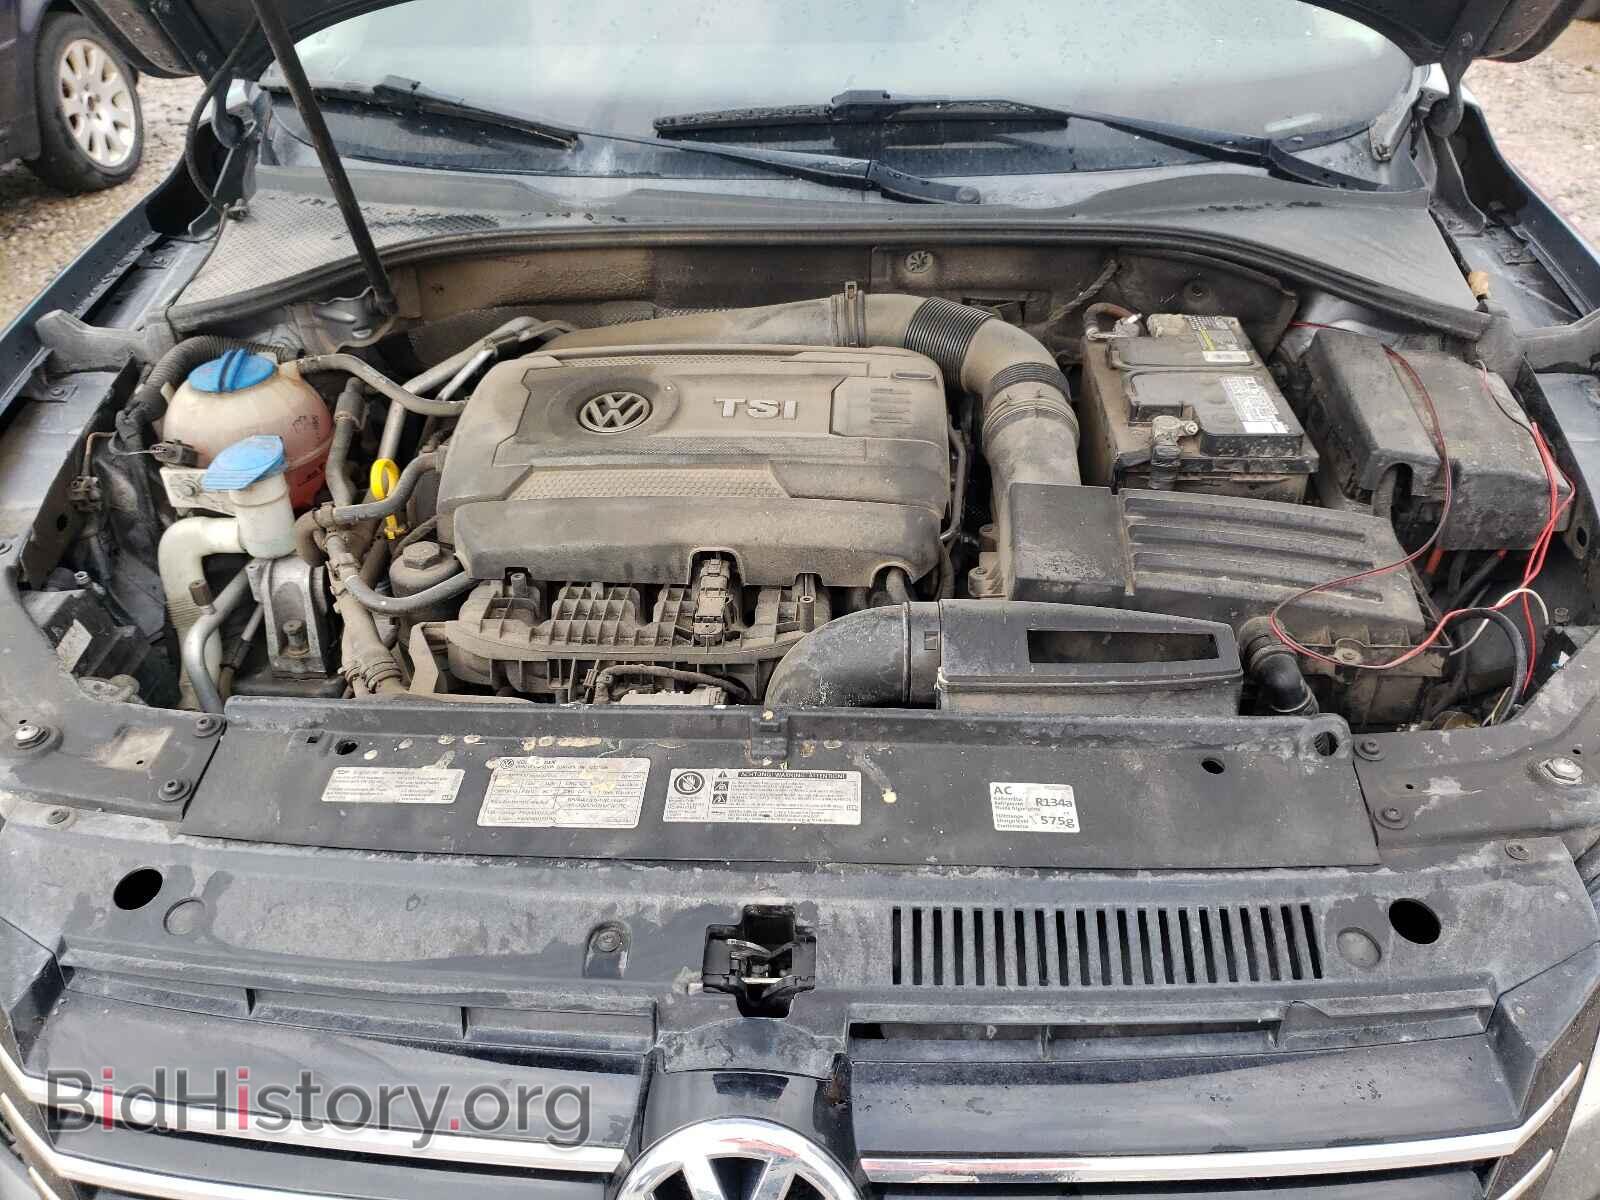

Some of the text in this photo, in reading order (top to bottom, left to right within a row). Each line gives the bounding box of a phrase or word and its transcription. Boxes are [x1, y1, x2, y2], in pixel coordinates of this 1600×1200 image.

[713, 397, 797, 420] TSI
[994, 785, 1013, 795] AC
[1035, 797, 1073, 808] R134a
[1040, 815, 1075, 829] 575g
